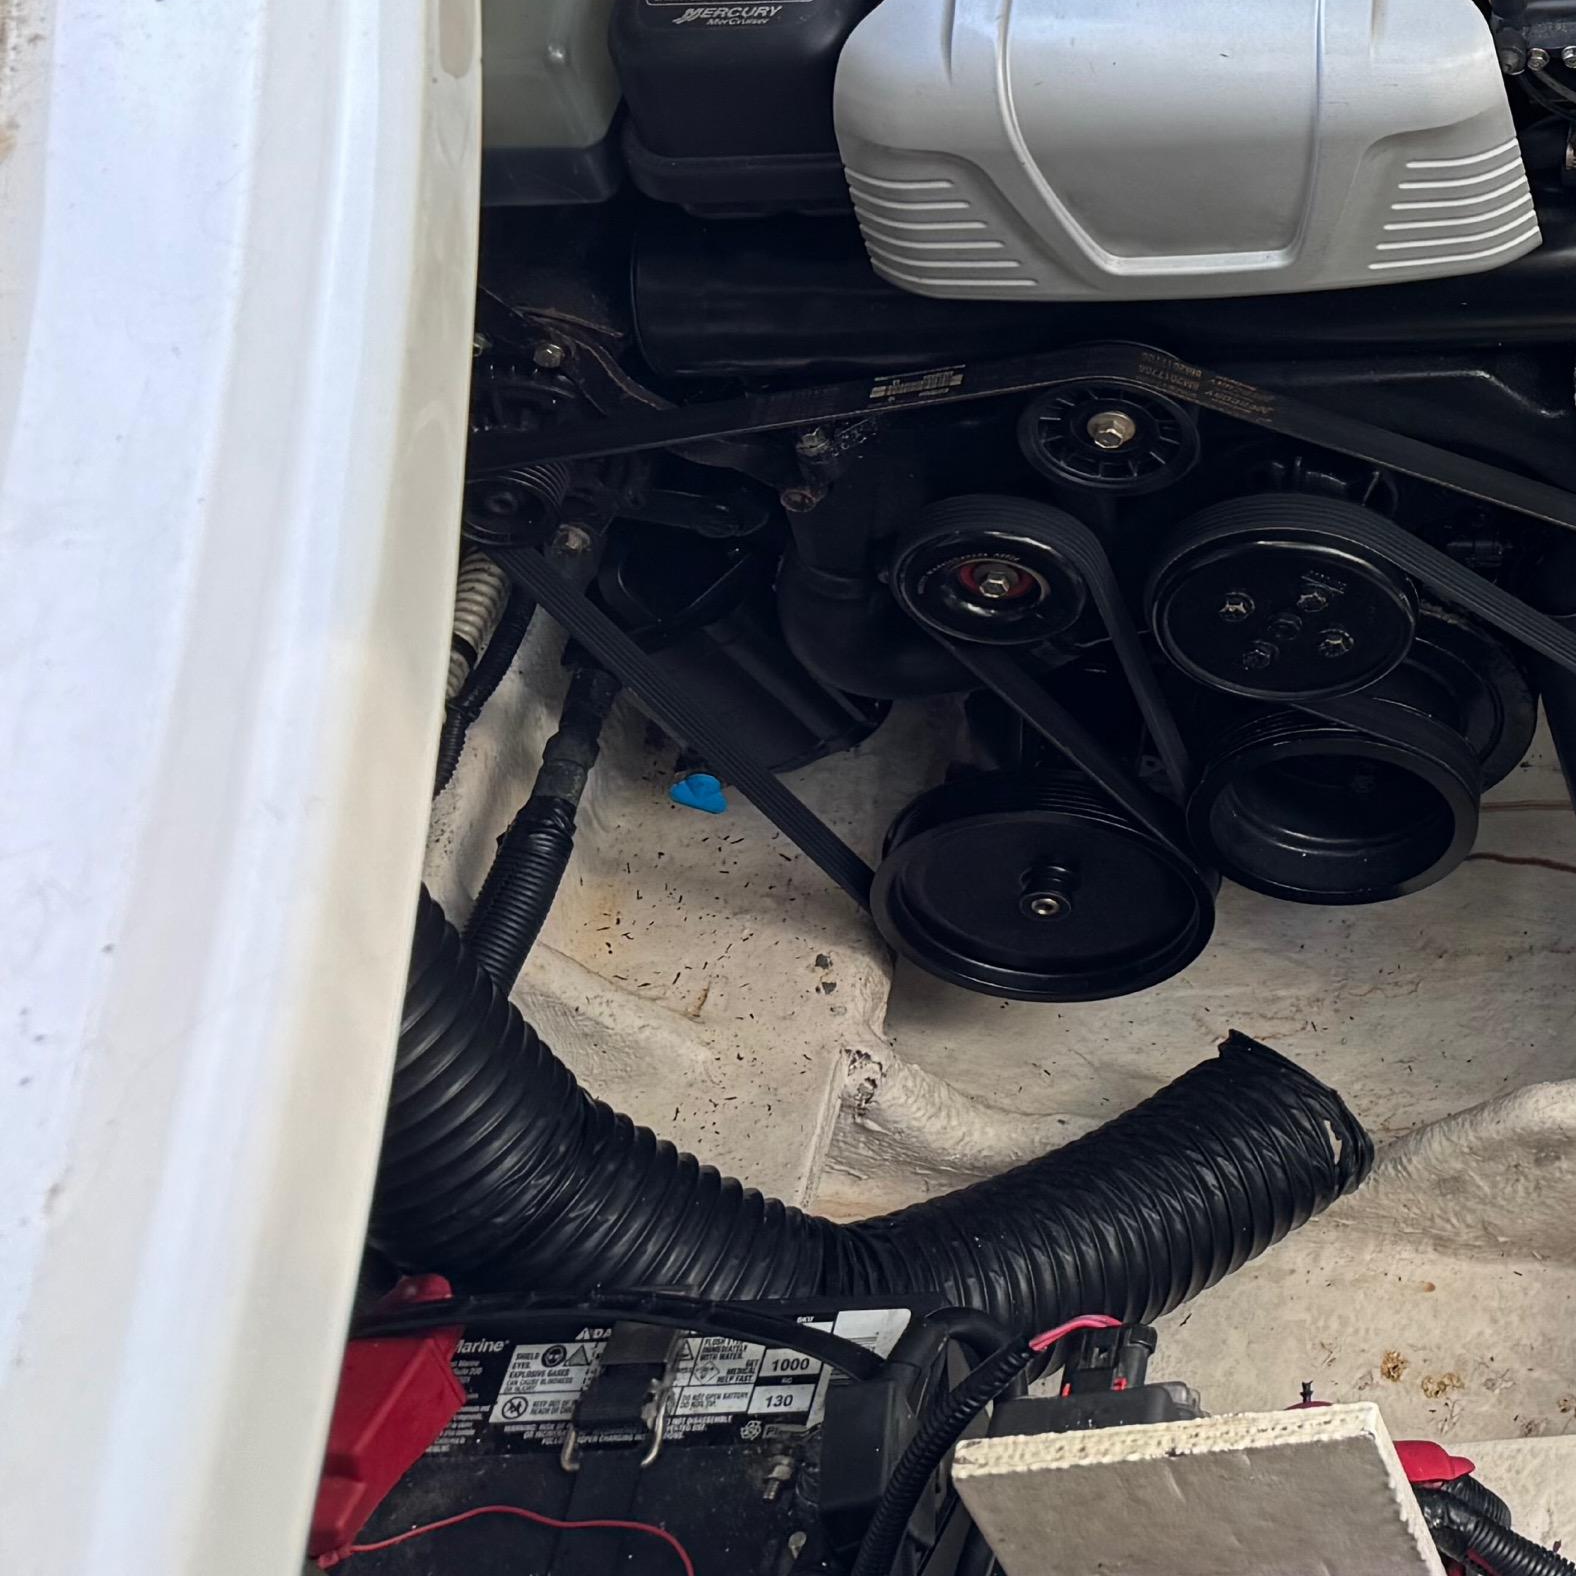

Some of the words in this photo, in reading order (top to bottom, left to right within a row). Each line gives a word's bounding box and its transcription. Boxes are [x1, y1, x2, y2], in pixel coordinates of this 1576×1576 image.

[679, 6, 782, 22] MERCURY
[771, 1358, 810, 1372] 1000
[765, 1394, 793, 1408] 130
